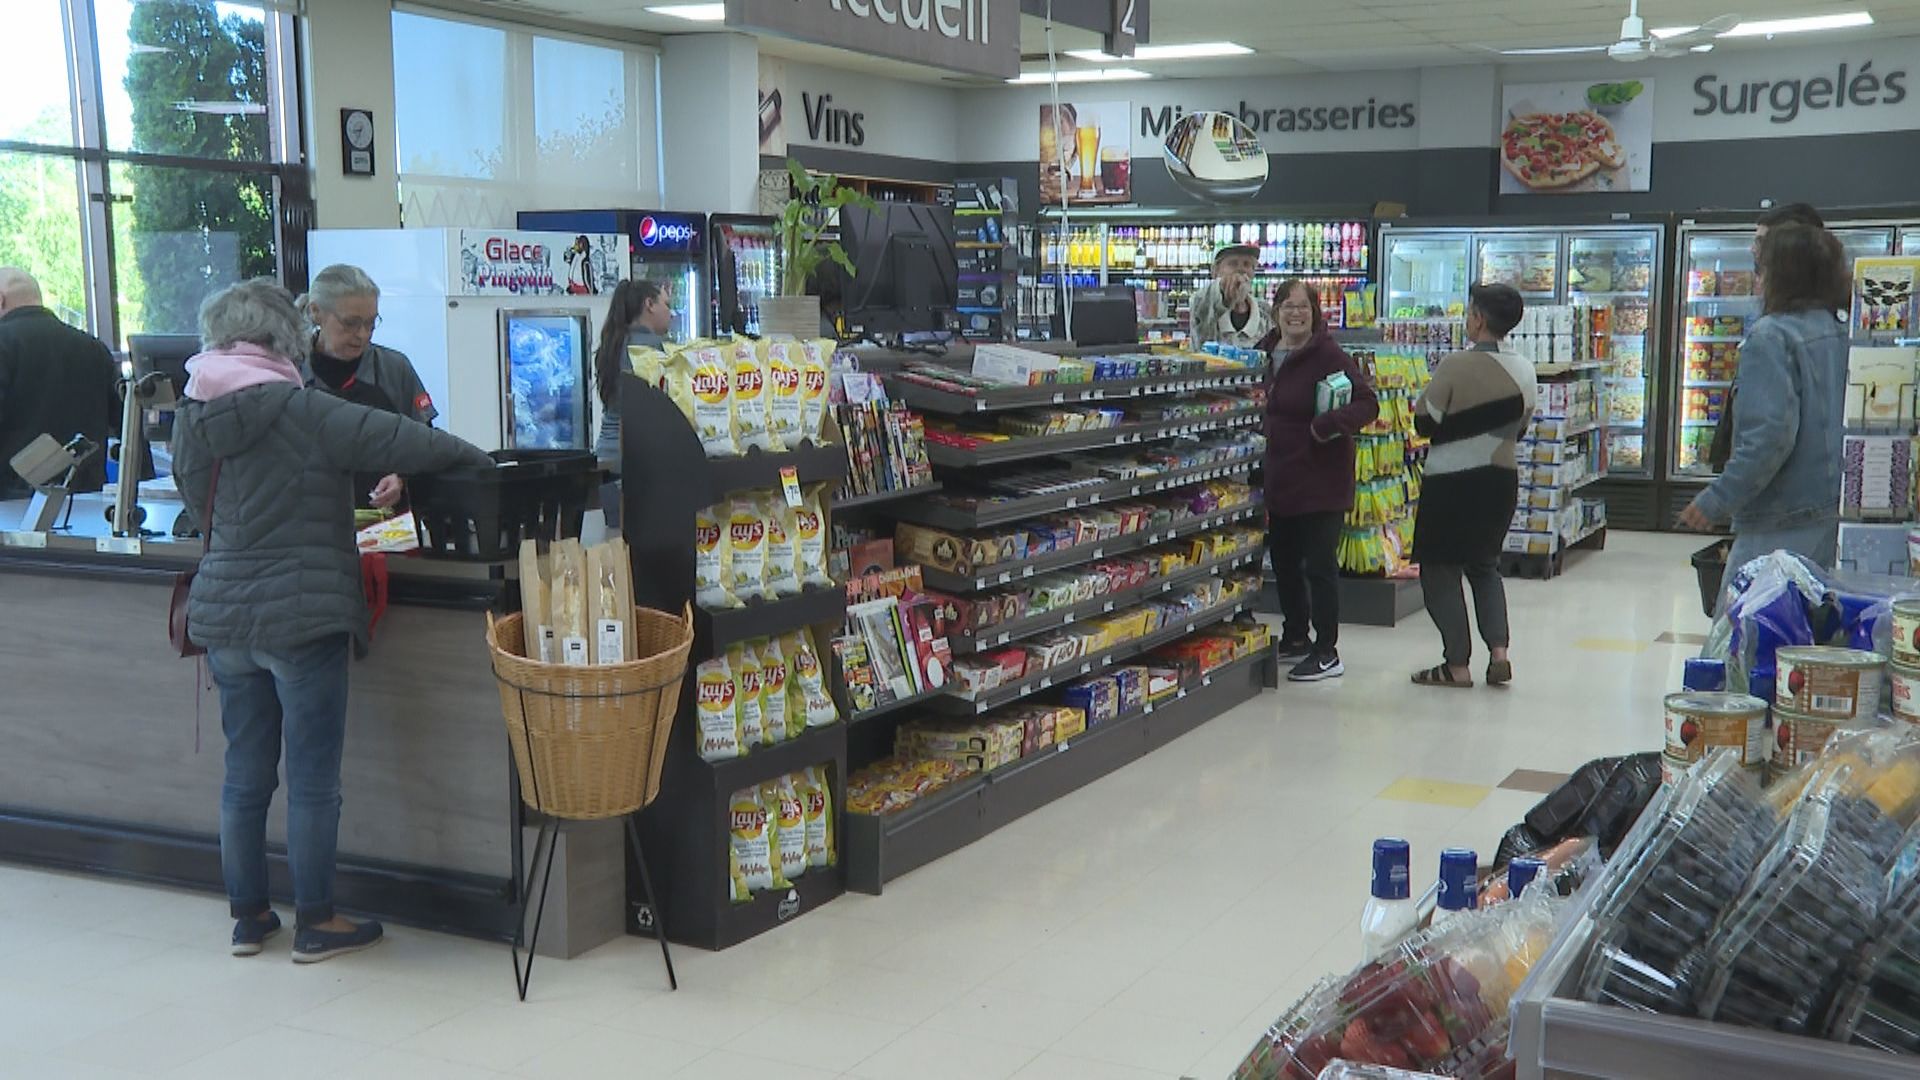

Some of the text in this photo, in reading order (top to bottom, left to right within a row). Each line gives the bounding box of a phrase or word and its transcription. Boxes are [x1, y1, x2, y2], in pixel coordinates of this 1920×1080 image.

[1693, 59, 1906, 124] Surgelés
[802, 91, 865, 146] Vins
[1140, 98, 1416, 137] Mibrasseries
[485, 237, 543, 263] Glace
[478, 264, 553, 293] Pingouin
[698, 680, 735, 705] Lay's
[731, 808, 767, 831] Lay's
